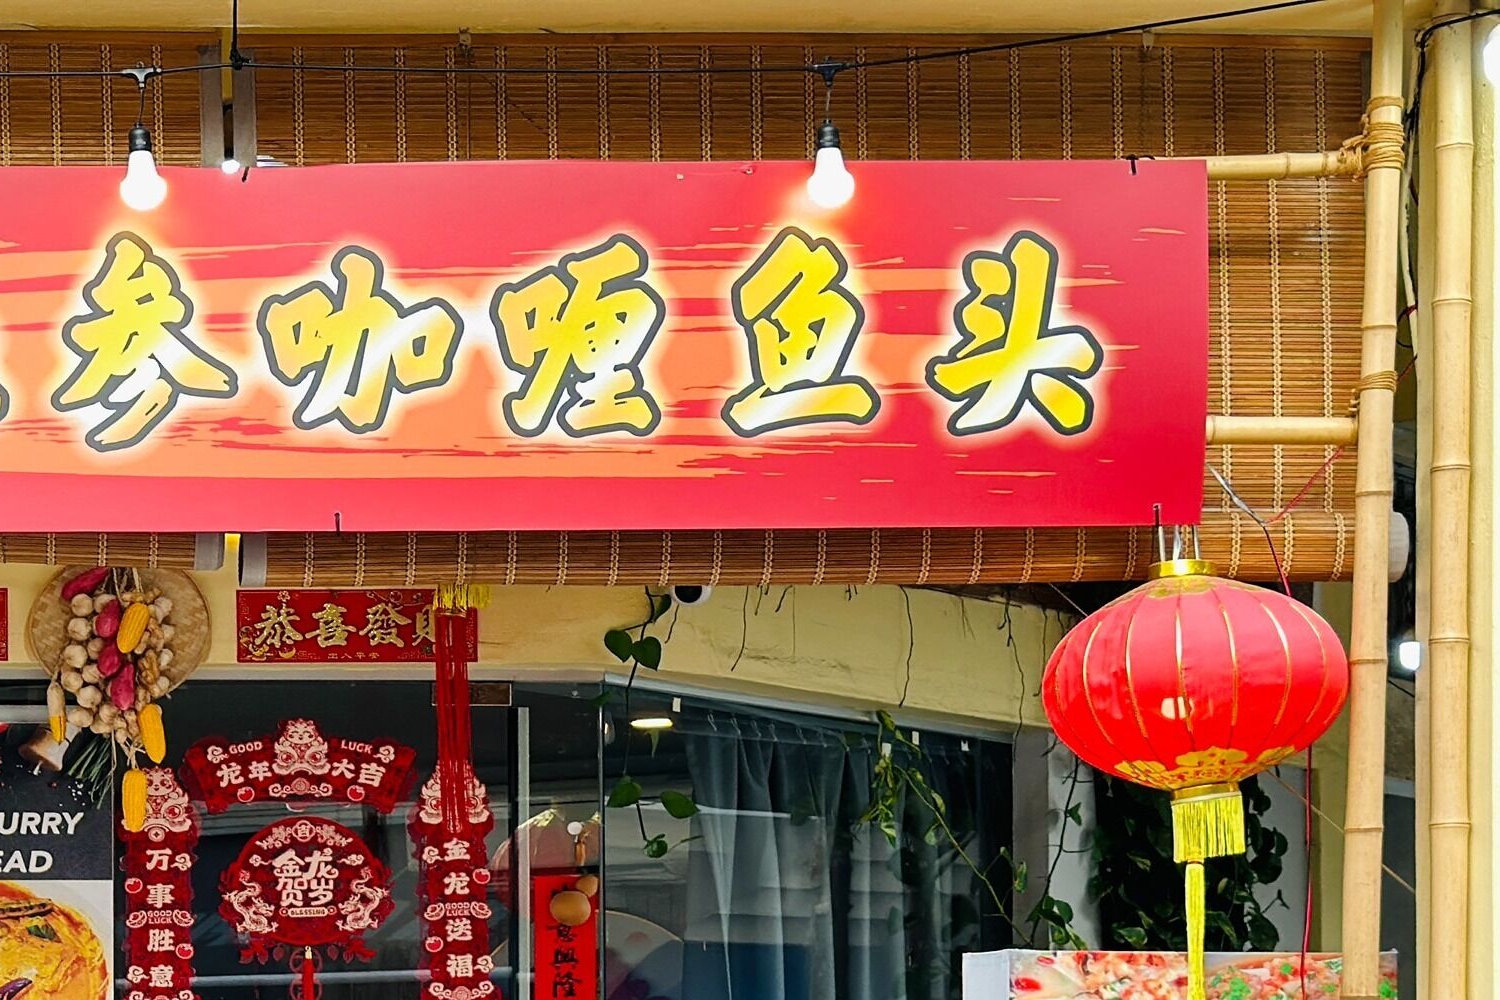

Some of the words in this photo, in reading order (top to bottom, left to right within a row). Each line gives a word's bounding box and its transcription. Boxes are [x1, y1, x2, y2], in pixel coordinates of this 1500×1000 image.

[216, 761, 272, 788] 龙年
[332, 758, 386, 787] 大吉
[229, 741, 263, 754] GOOD
[340, 739, 373, 754] LUCK
[146, 848, 175, 988] 万事胜意
[443, 837, 473, 978] 金龙送福
